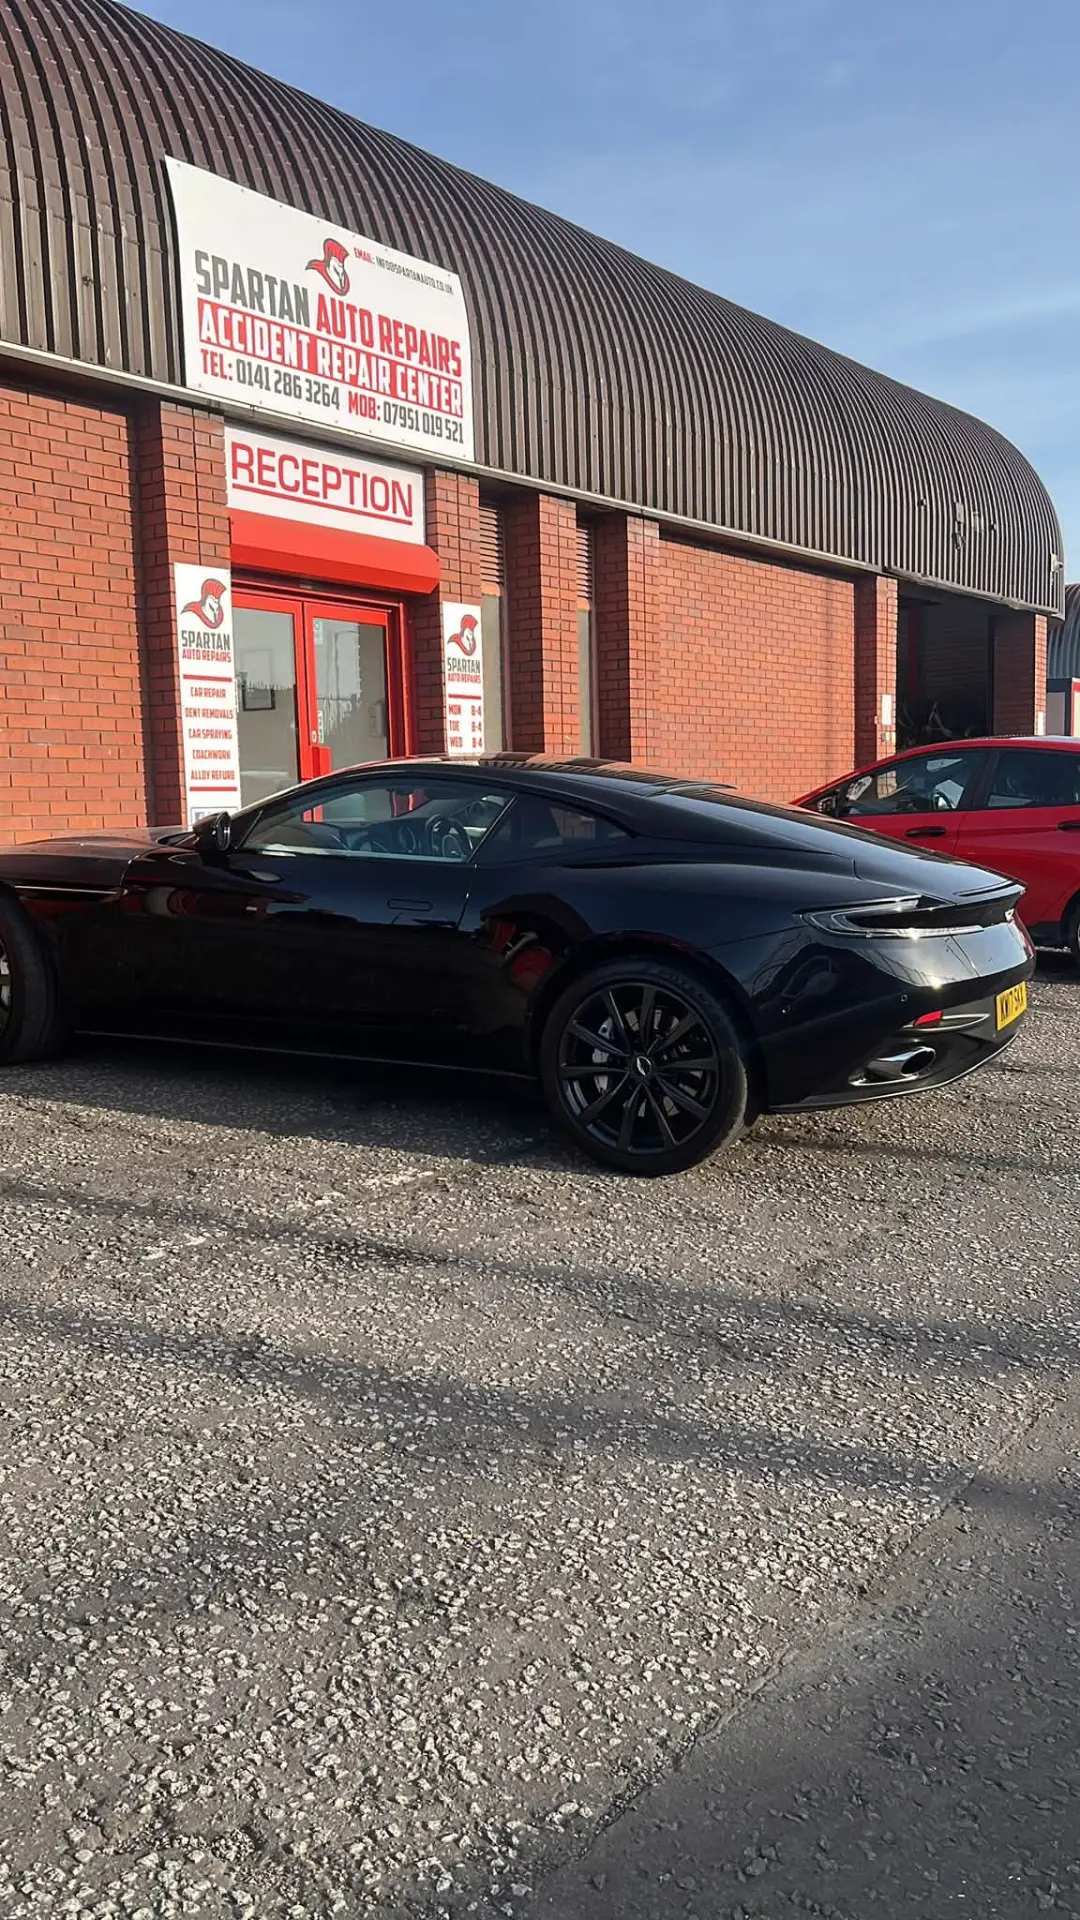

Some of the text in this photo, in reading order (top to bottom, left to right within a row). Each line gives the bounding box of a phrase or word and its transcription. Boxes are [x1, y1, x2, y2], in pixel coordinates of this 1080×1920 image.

[354, 247, 375, 265] EMAIL:
[194, 249, 462, 378] SPARTAN AUTO REPAIRS
[199, 303, 463, 418] ACCIDENT REPAIR CENTER
[200, 348, 464, 444] TEL: 0141 286 3264 MOB: 07951 019 521
[231, 441, 413, 517] RECEPTION
[181, 629, 230, 651] SPARTAN
[182, 648, 232, 663] AUTO REPAIRS
[447, 657, 480, 674] SPARTAN
[190, 686, 226, 698] CAR REPAIR
[185, 707, 233, 719] DENT REMOVALS
[448, 704, 461, 715] MON
[449, 720, 460, 731] TUE
[188, 728, 233, 740] CAR SPRAYING
[449, 736, 463, 748] WED
[192, 749, 231, 760] COACHWORK
[190, 769, 235, 780] ALLOY REFURB
